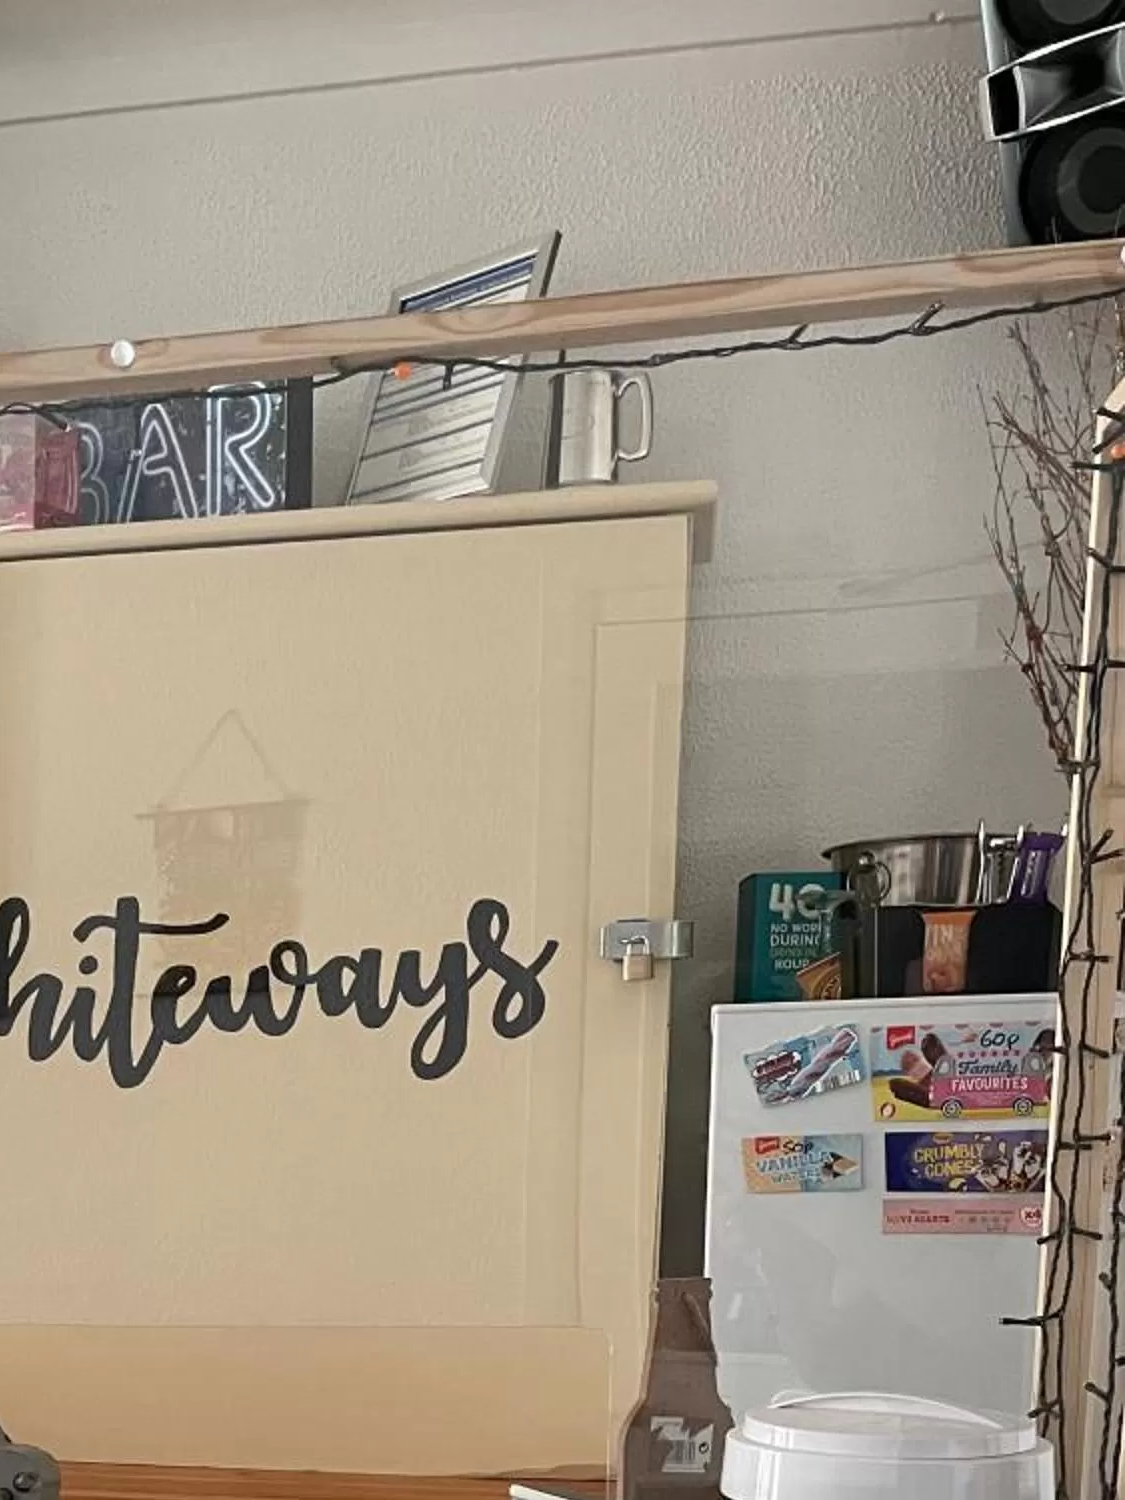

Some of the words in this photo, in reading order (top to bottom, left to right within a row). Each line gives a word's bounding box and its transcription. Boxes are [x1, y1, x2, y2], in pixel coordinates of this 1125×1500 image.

[771, 923, 788, 933] NO
[792, 923, 819, 933] WOR
[980, 1029, 1020, 1049] 60p
[957, 1060, 1019, 1078] Family
[951, 1077, 1028, 1092] FAVOURITES
[758, 1150, 832, 1172] VANILLA
[914, 1142, 985, 1163] CRUMBLY
[925, 1159, 983, 1178] CONES
